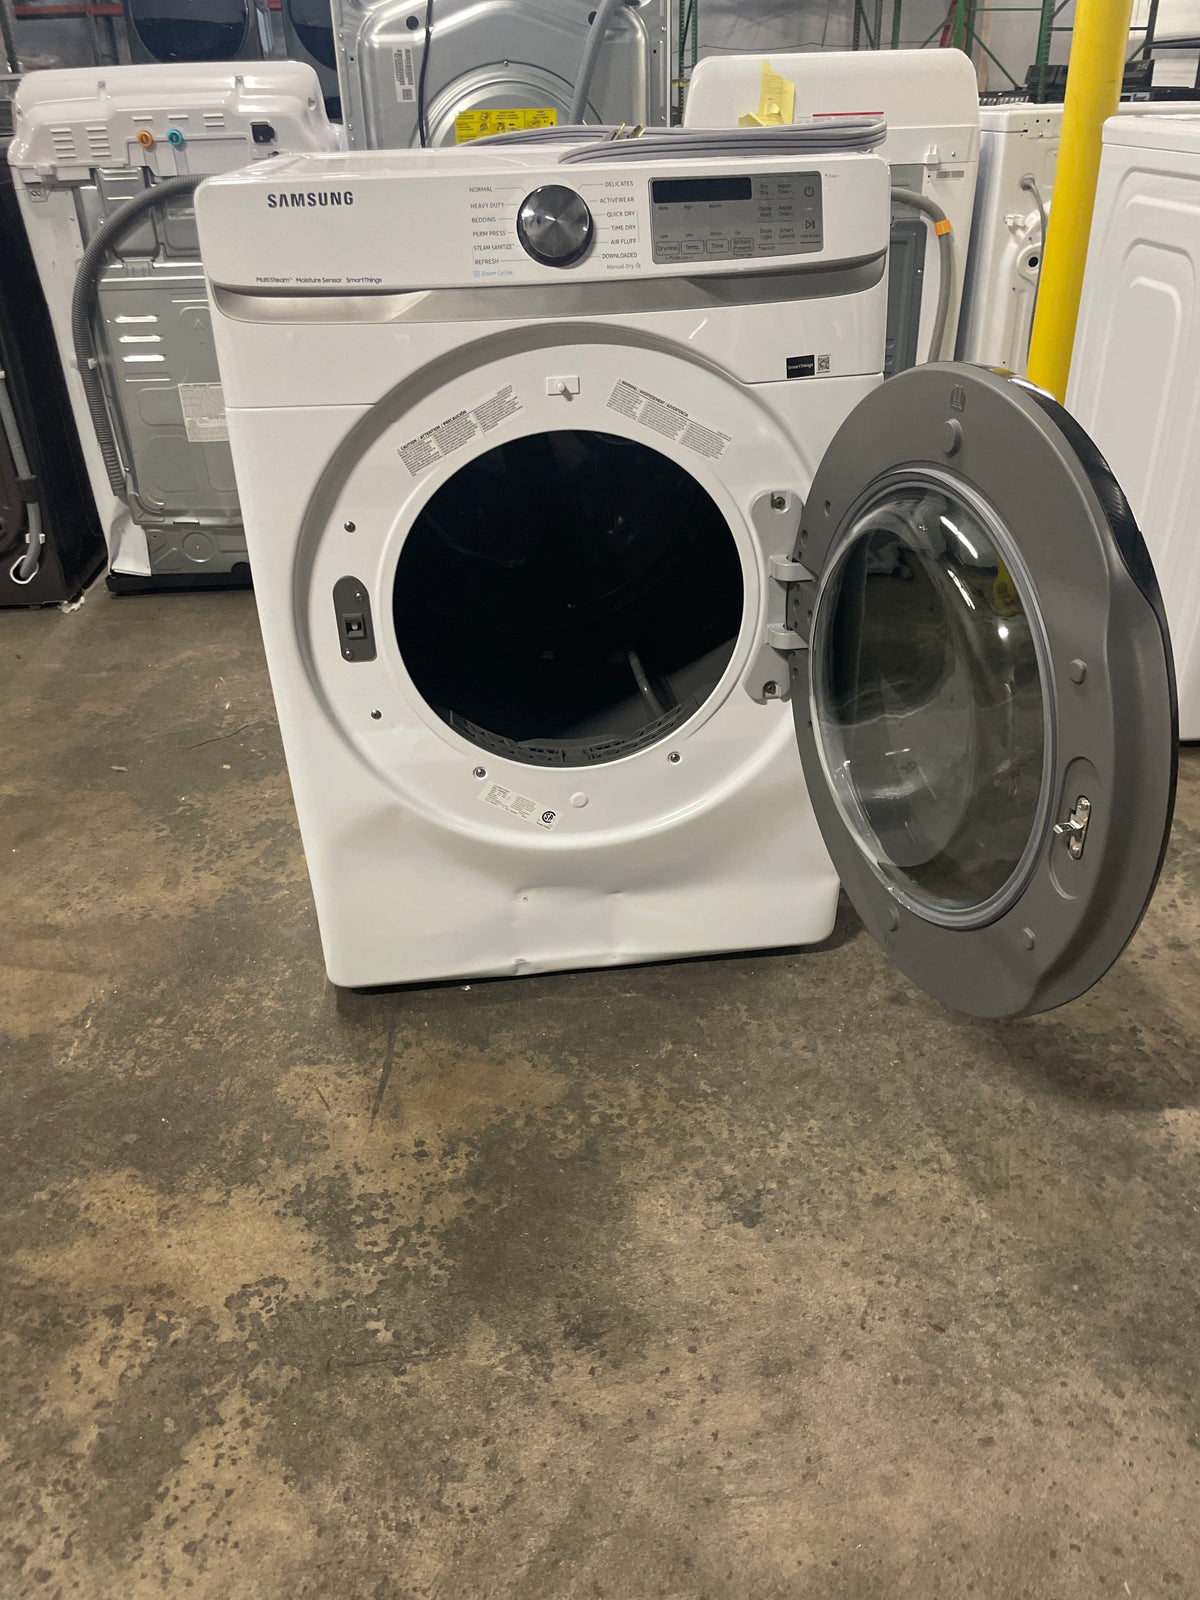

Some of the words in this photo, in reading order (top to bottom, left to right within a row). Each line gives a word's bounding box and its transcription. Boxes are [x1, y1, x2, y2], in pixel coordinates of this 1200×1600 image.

[267, 191, 354, 208] SAMSUNG
[622, 380, 638, 391] WARNING
[666, 403, 689, 417] ADVERTENCIA
[400, 439, 418, 451] CAUTION
[420, 425, 440, 439] ATTENTION
[443, 410, 467, 426] PRECAUCIÓN
